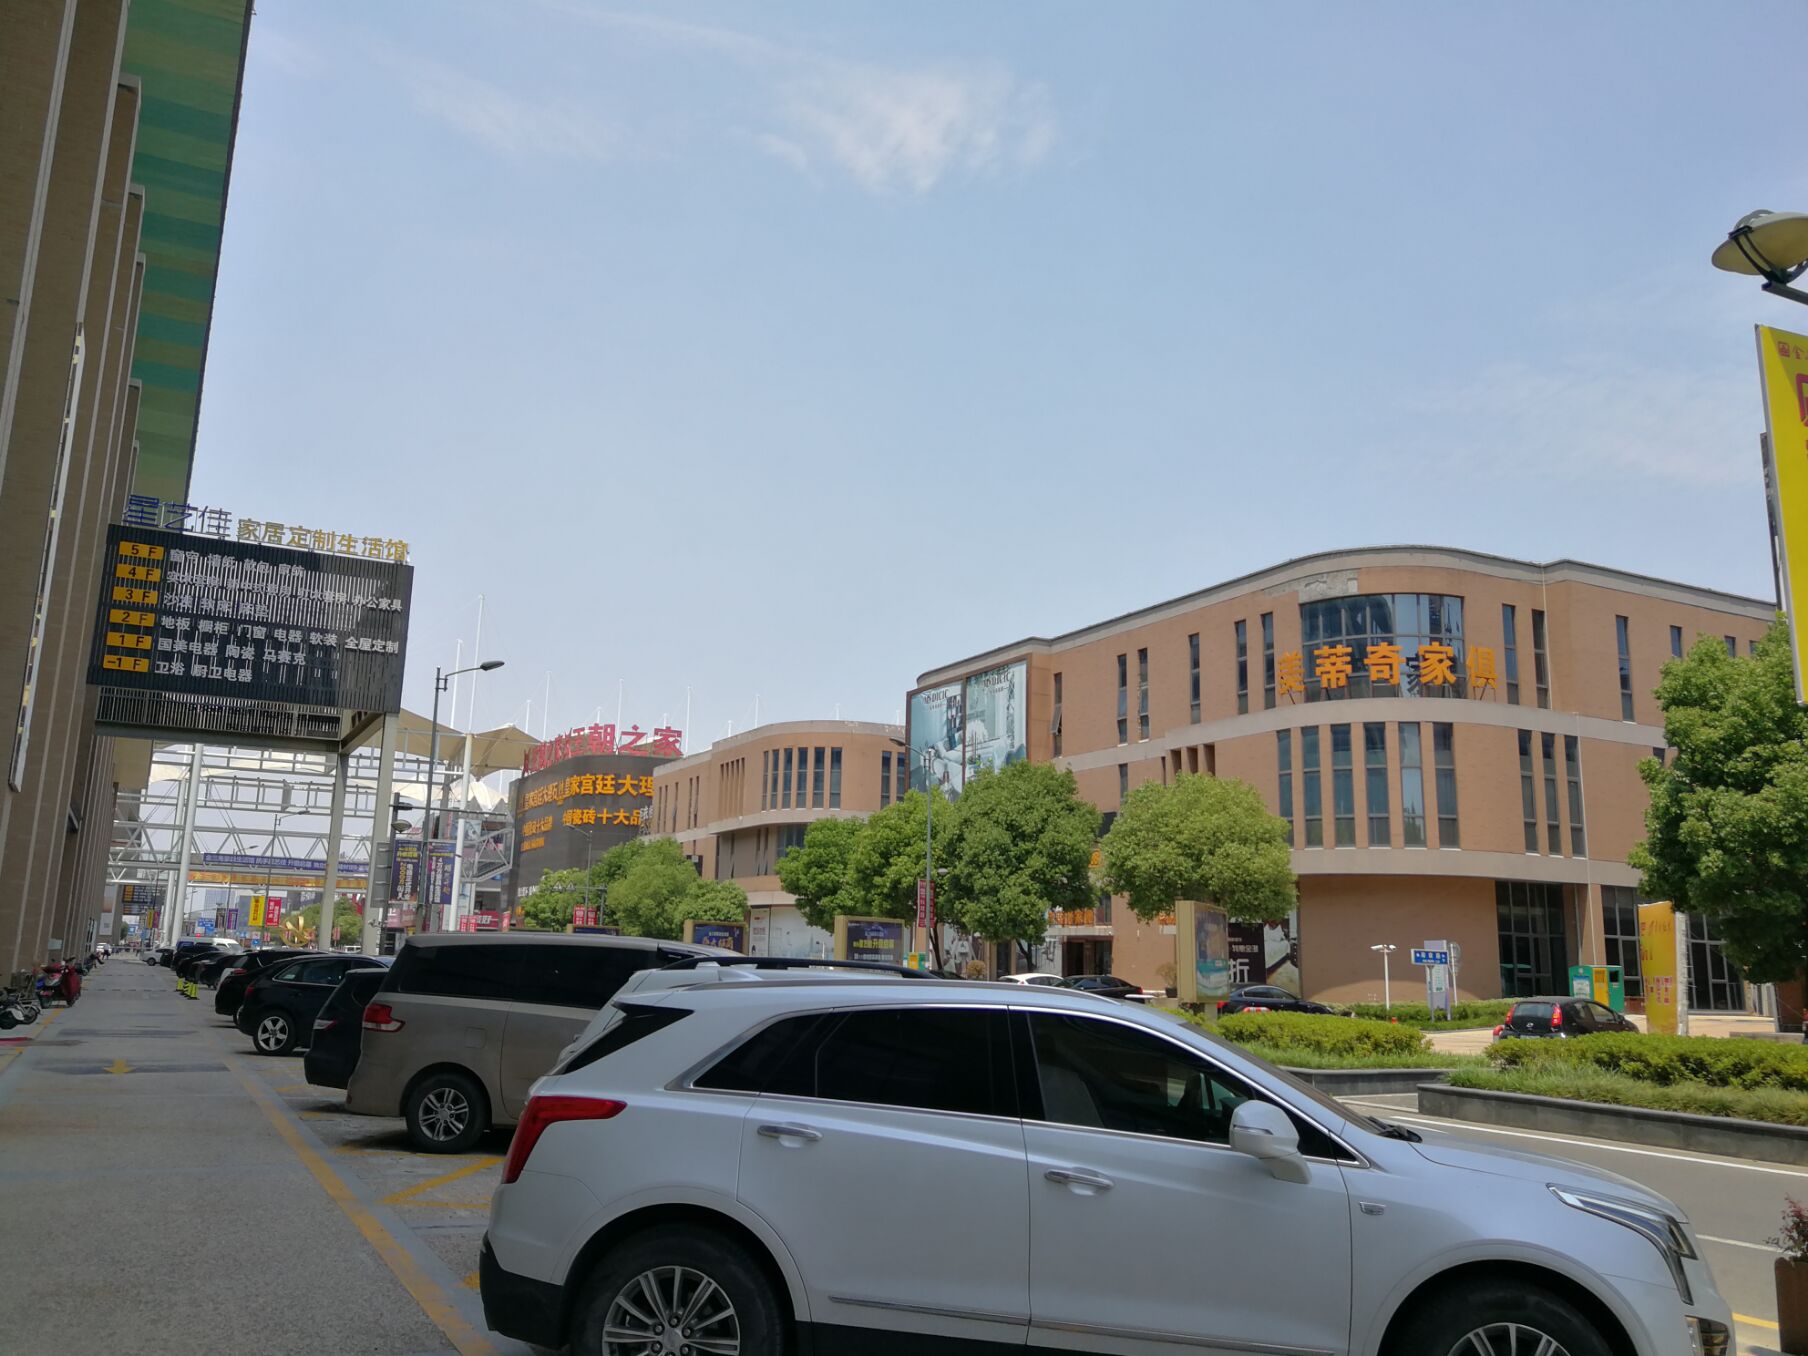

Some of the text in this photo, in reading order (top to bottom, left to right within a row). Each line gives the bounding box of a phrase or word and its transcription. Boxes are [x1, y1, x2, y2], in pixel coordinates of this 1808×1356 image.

[236, 518, 409, 561] 家居定制生活馆
[352, 594, 402, 612] 办公家具
[157, 637, 306, 666] 国美电器 陶瓷 马赛克
[161, 615, 399, 654] 地板 橱柜 门窗 电器 软装 全屋定制
[154, 661, 252, 683] 卫浴 厨卫电器
[1277, 642, 1498, 695] 美蒂奇家俱
